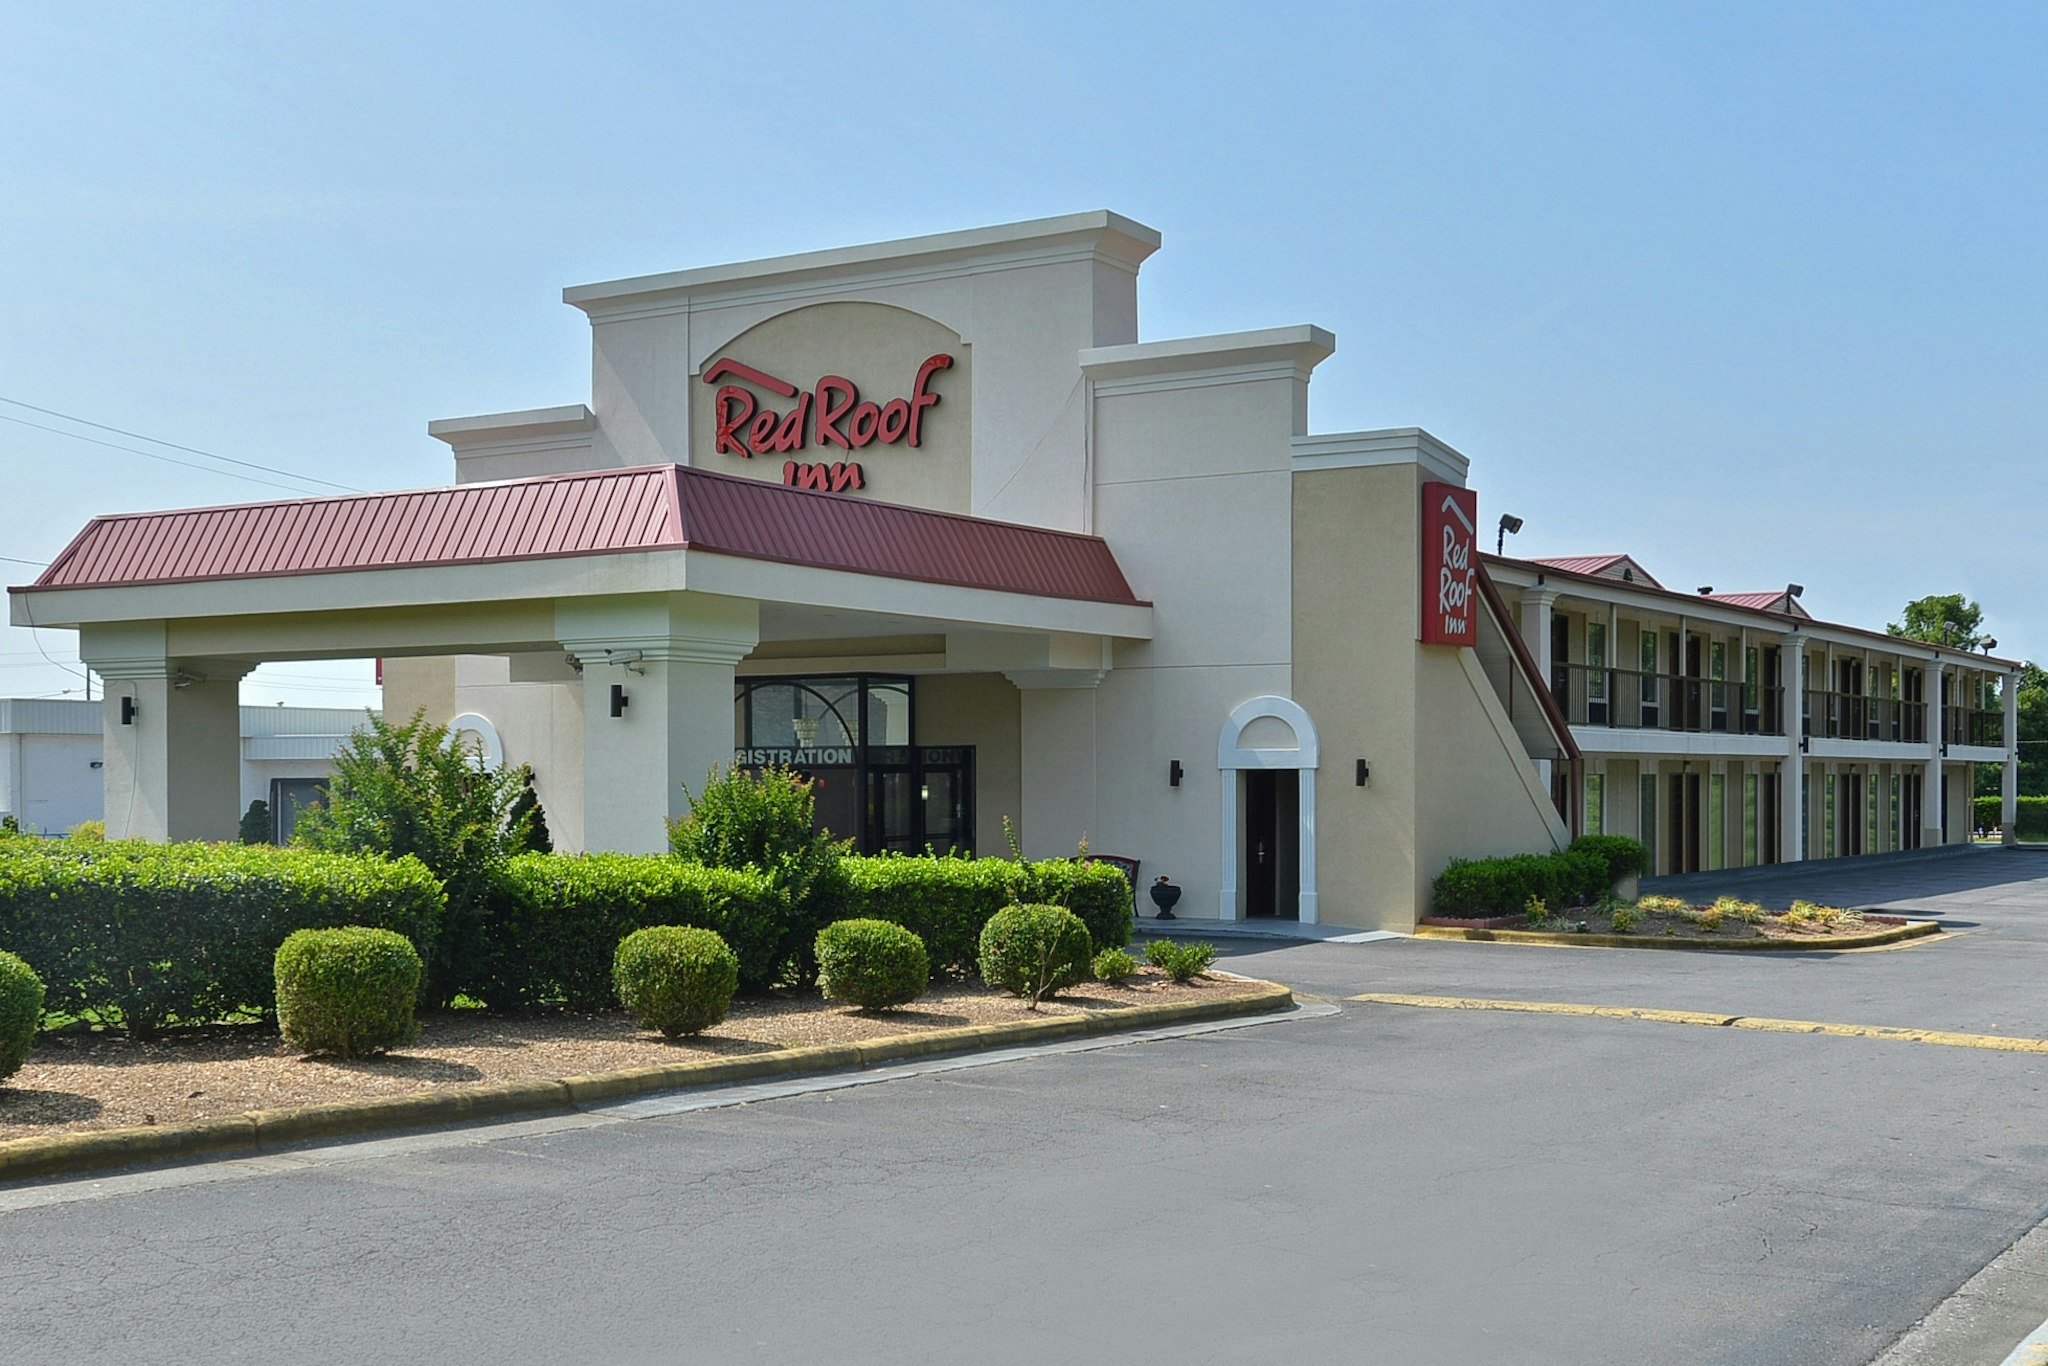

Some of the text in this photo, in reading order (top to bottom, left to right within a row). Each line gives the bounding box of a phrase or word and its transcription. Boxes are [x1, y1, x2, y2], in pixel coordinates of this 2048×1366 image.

[716, 354, 954, 458] Red Roof
[1443, 524, 1469, 570] Red
[1439, 566, 1475, 617] Roof
